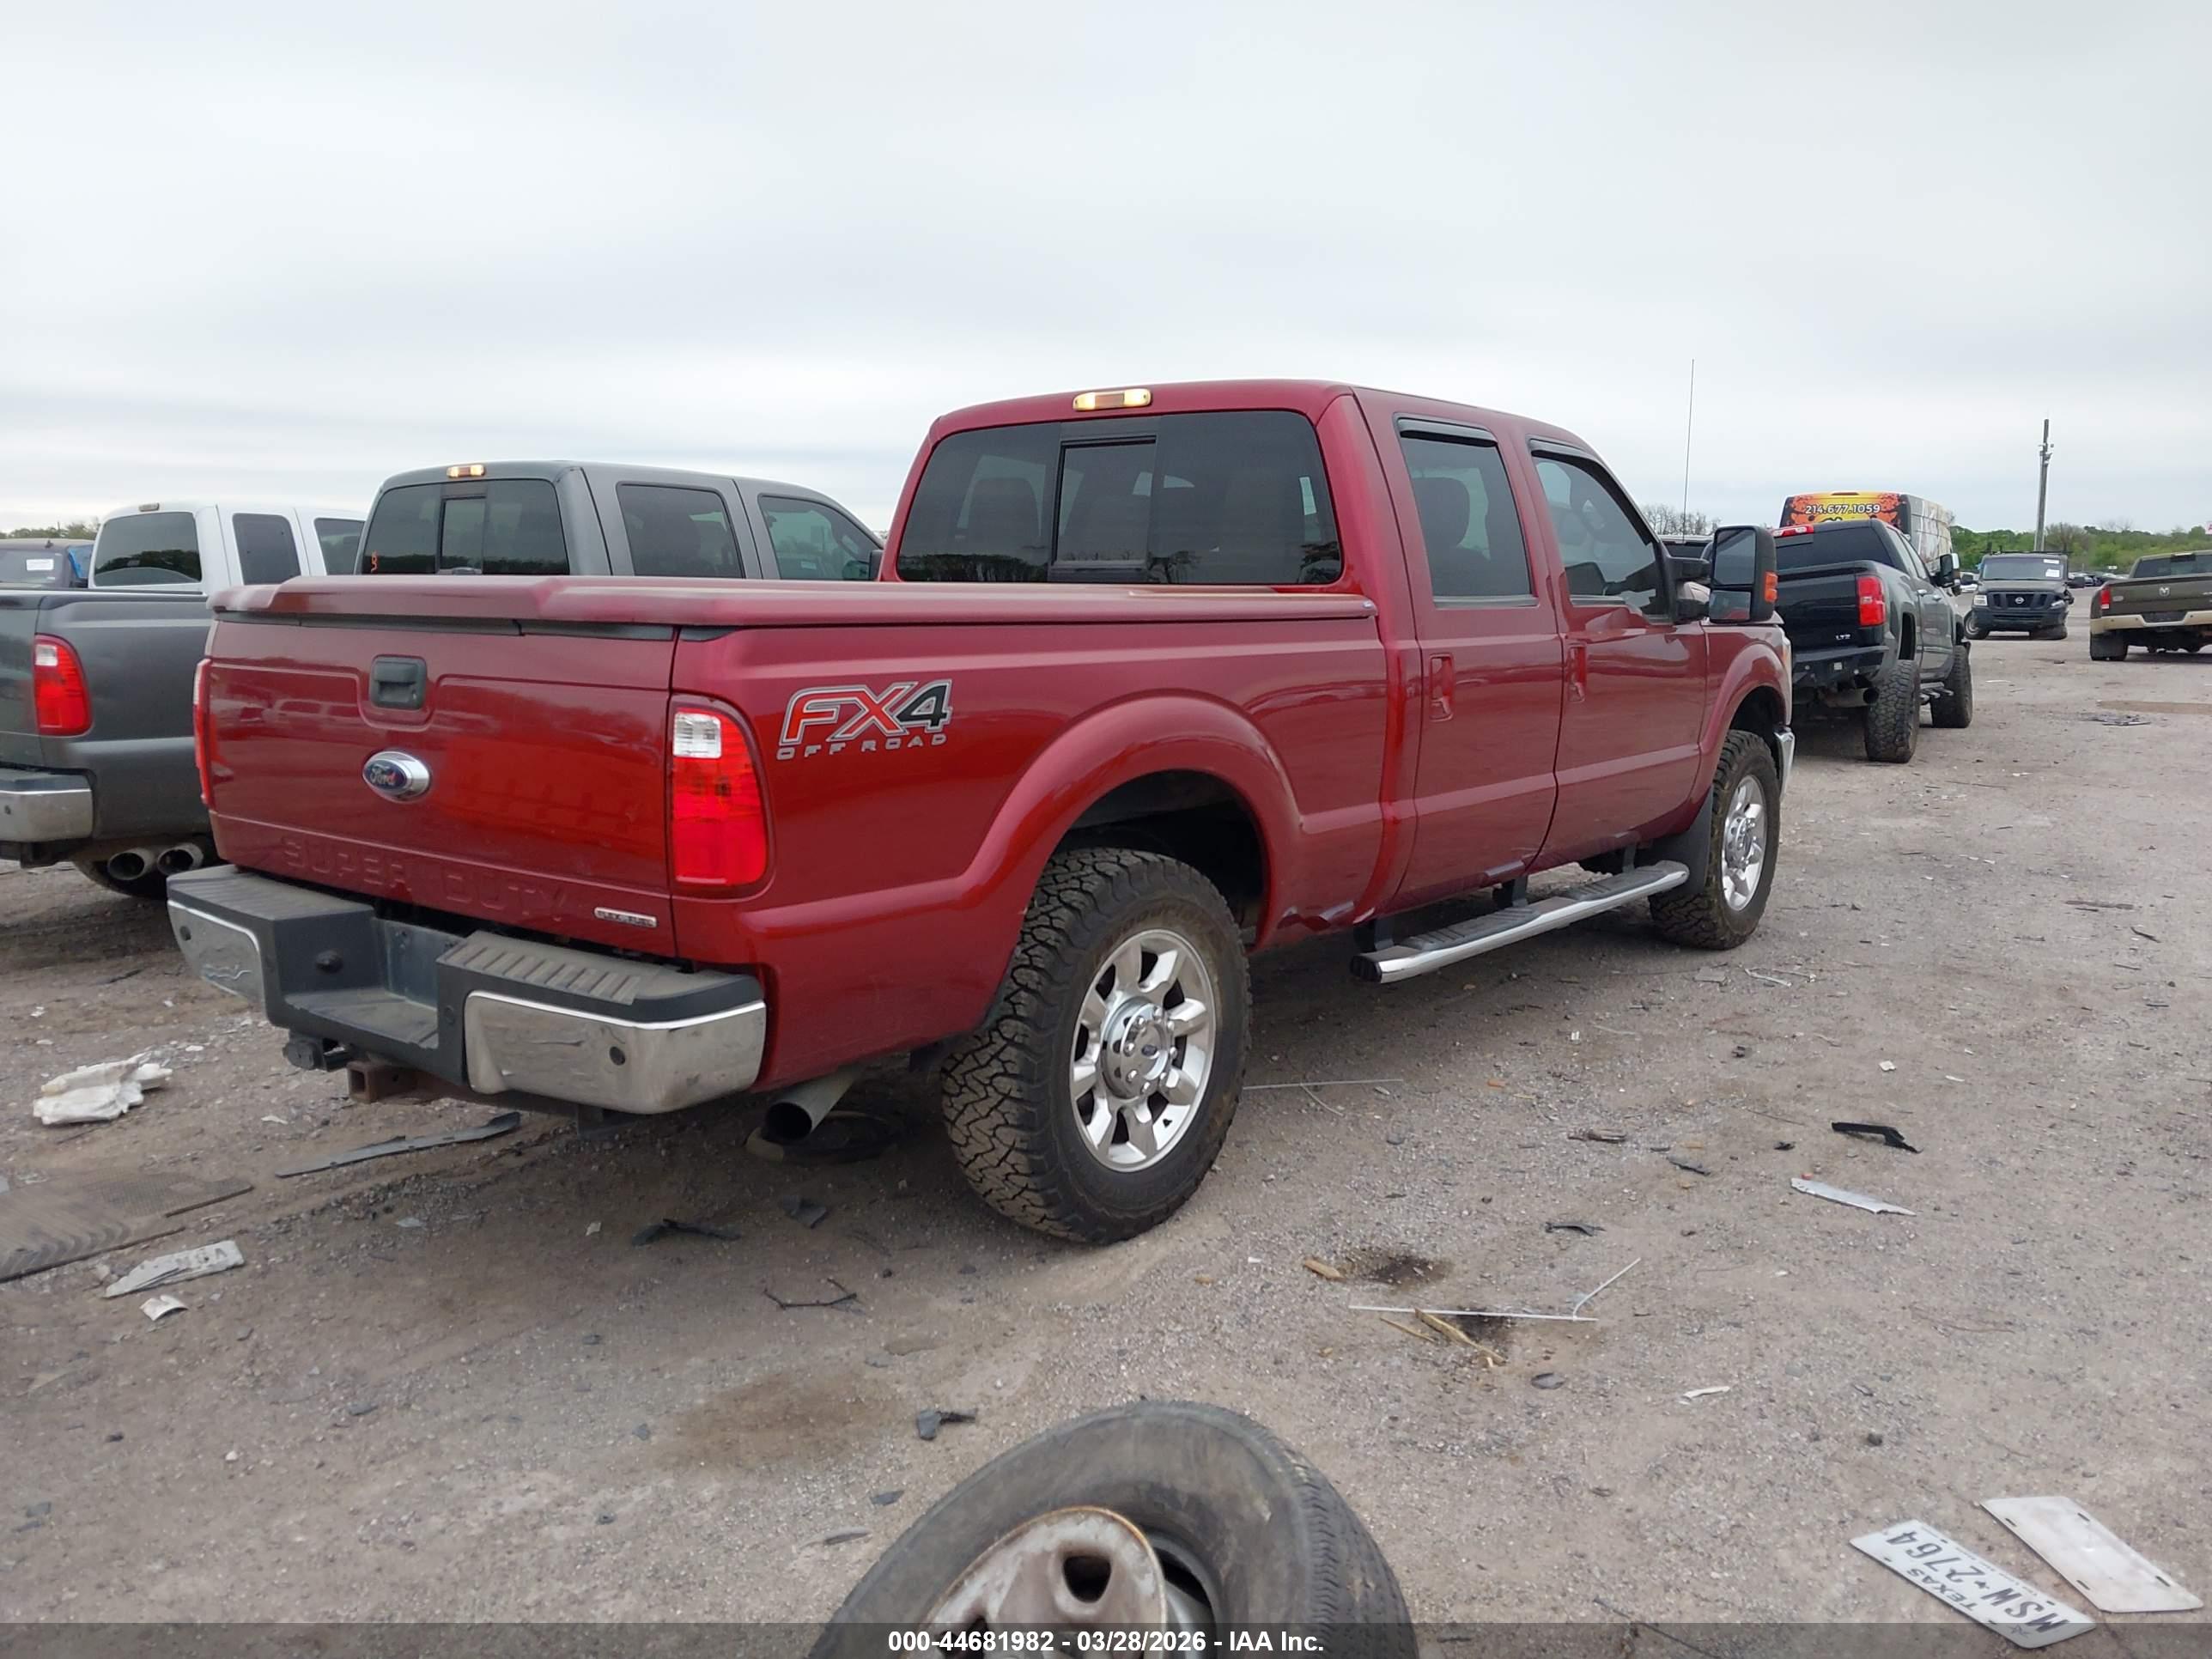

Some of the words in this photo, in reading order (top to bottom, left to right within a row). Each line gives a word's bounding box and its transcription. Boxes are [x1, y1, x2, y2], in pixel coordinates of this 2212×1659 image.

[1805, 504, 1881, 514] 214.677.1059
[779, 678, 953, 746] FX4
[776, 741, 846, 760] OFF
[861, 733, 947, 752] ROAD
[370, 763, 397, 786] Ford
[282, 836, 414, 892] SUPER
[442, 867, 567, 922] DUTY
[1907, 1568, 1978, 1612] TEXAS
